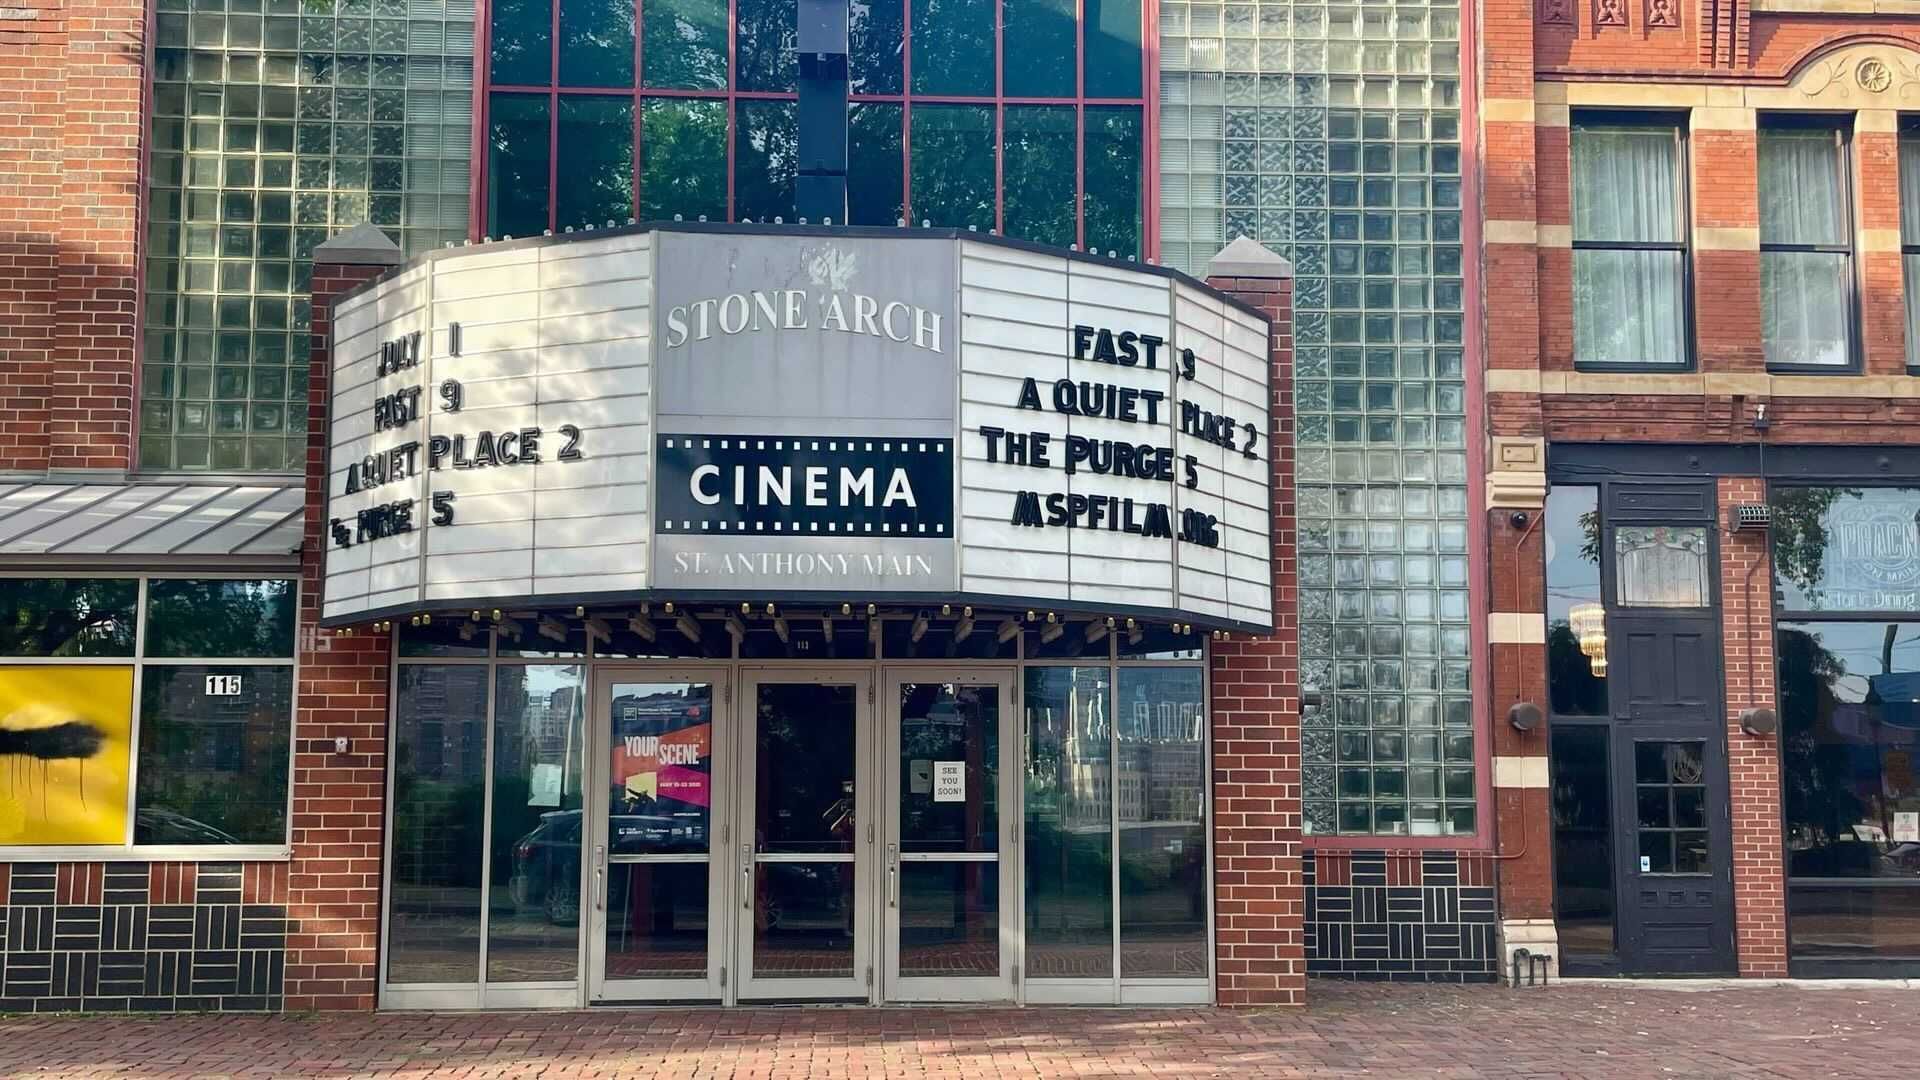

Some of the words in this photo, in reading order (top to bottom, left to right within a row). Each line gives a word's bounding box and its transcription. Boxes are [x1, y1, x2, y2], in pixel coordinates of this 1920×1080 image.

[666, 289, 808, 349] STONE
[821, 293, 944, 354] ARCH
[377, 330, 421, 378] JULY
[448, 322, 462, 357] 1
[1073, 324, 1163, 370] FAST
[1182, 348, 1196, 381] 9
[373, 384, 421, 433] FAST
[439, 377, 462, 414] 9
[1016, 377, 1043, 412] A
[1052, 378, 1164, 425] QUIET
[1181, 399, 1236, 451] PLACE
[1243, 422, 1258, 461] 2
[345, 462, 361, 495] A
[361, 441, 419, 490] QUIET
[427, 426, 541, 472] PLACE
[557, 422, 583, 463] 2
[978, 425, 1051, 468] THE
[1063, 432, 1176, 483] PURGE
[1185, 454, 1199, 490] 5
[689, 464, 917, 508] CINEMA
[357, 498, 413, 544] PURGE
[431, 490, 455, 527] 5
[674, 550, 709, 575] ST.
[718, 552, 856, 576] ANTHONY
[863, 554, 934, 577] MAIN
[208, 676, 240, 694] 115
[624, 735, 659, 757] YOUR
[659, 743, 700, 765] SCENE
[942, 767, 958, 775] SEE
[937, 787, 962, 796] SOON!
[942, 777, 958, 785] YOU
